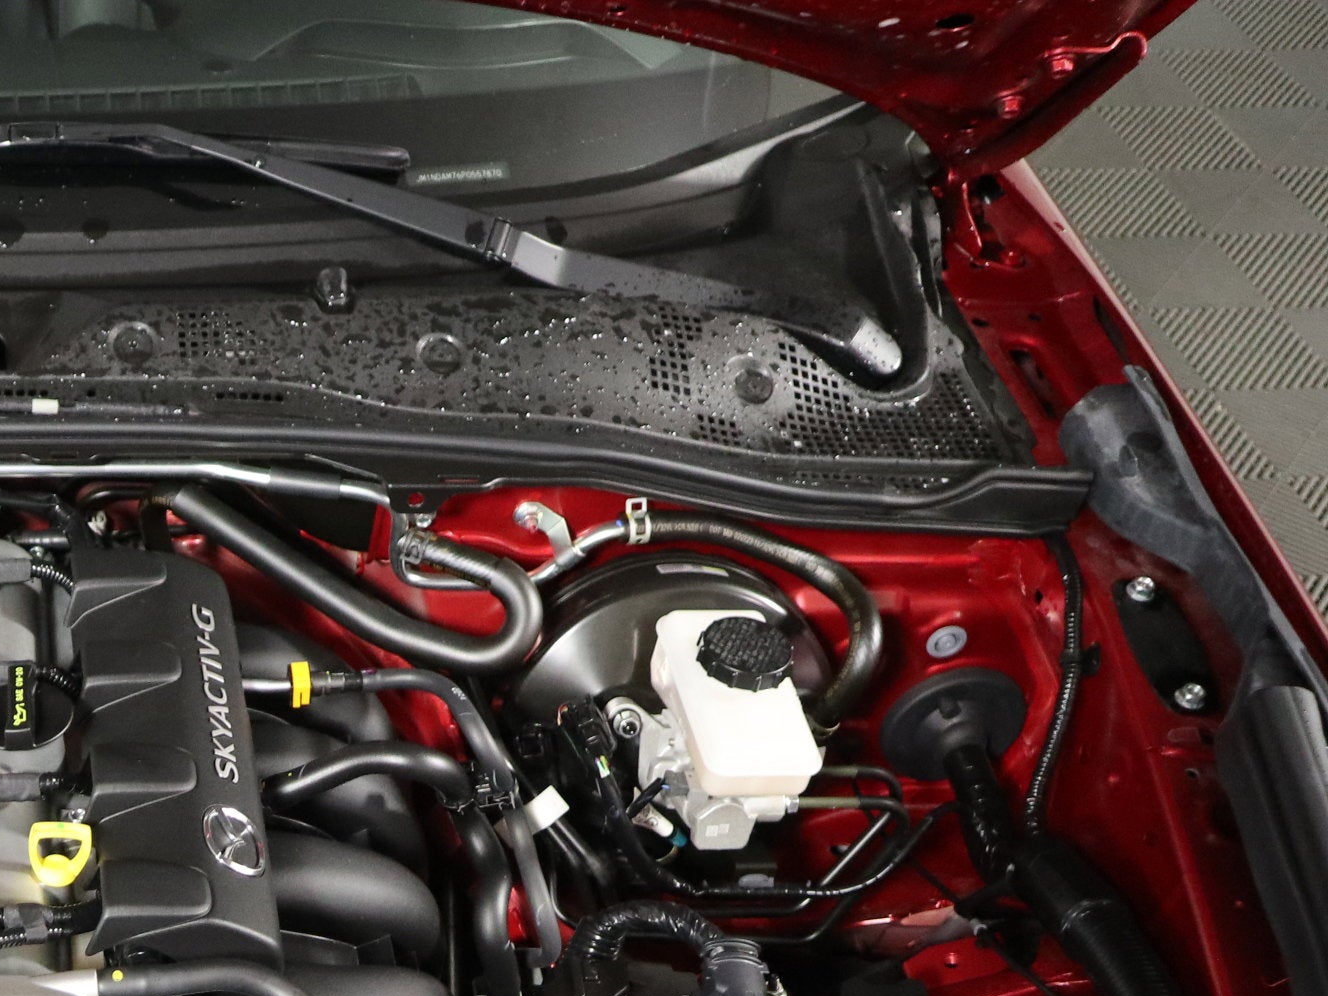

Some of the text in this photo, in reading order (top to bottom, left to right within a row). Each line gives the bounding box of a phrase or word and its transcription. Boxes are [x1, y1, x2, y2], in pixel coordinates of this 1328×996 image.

[15, 667, 24, 702] SAE 0W-20
[191, 603, 240, 784] SKYACTIV-G
